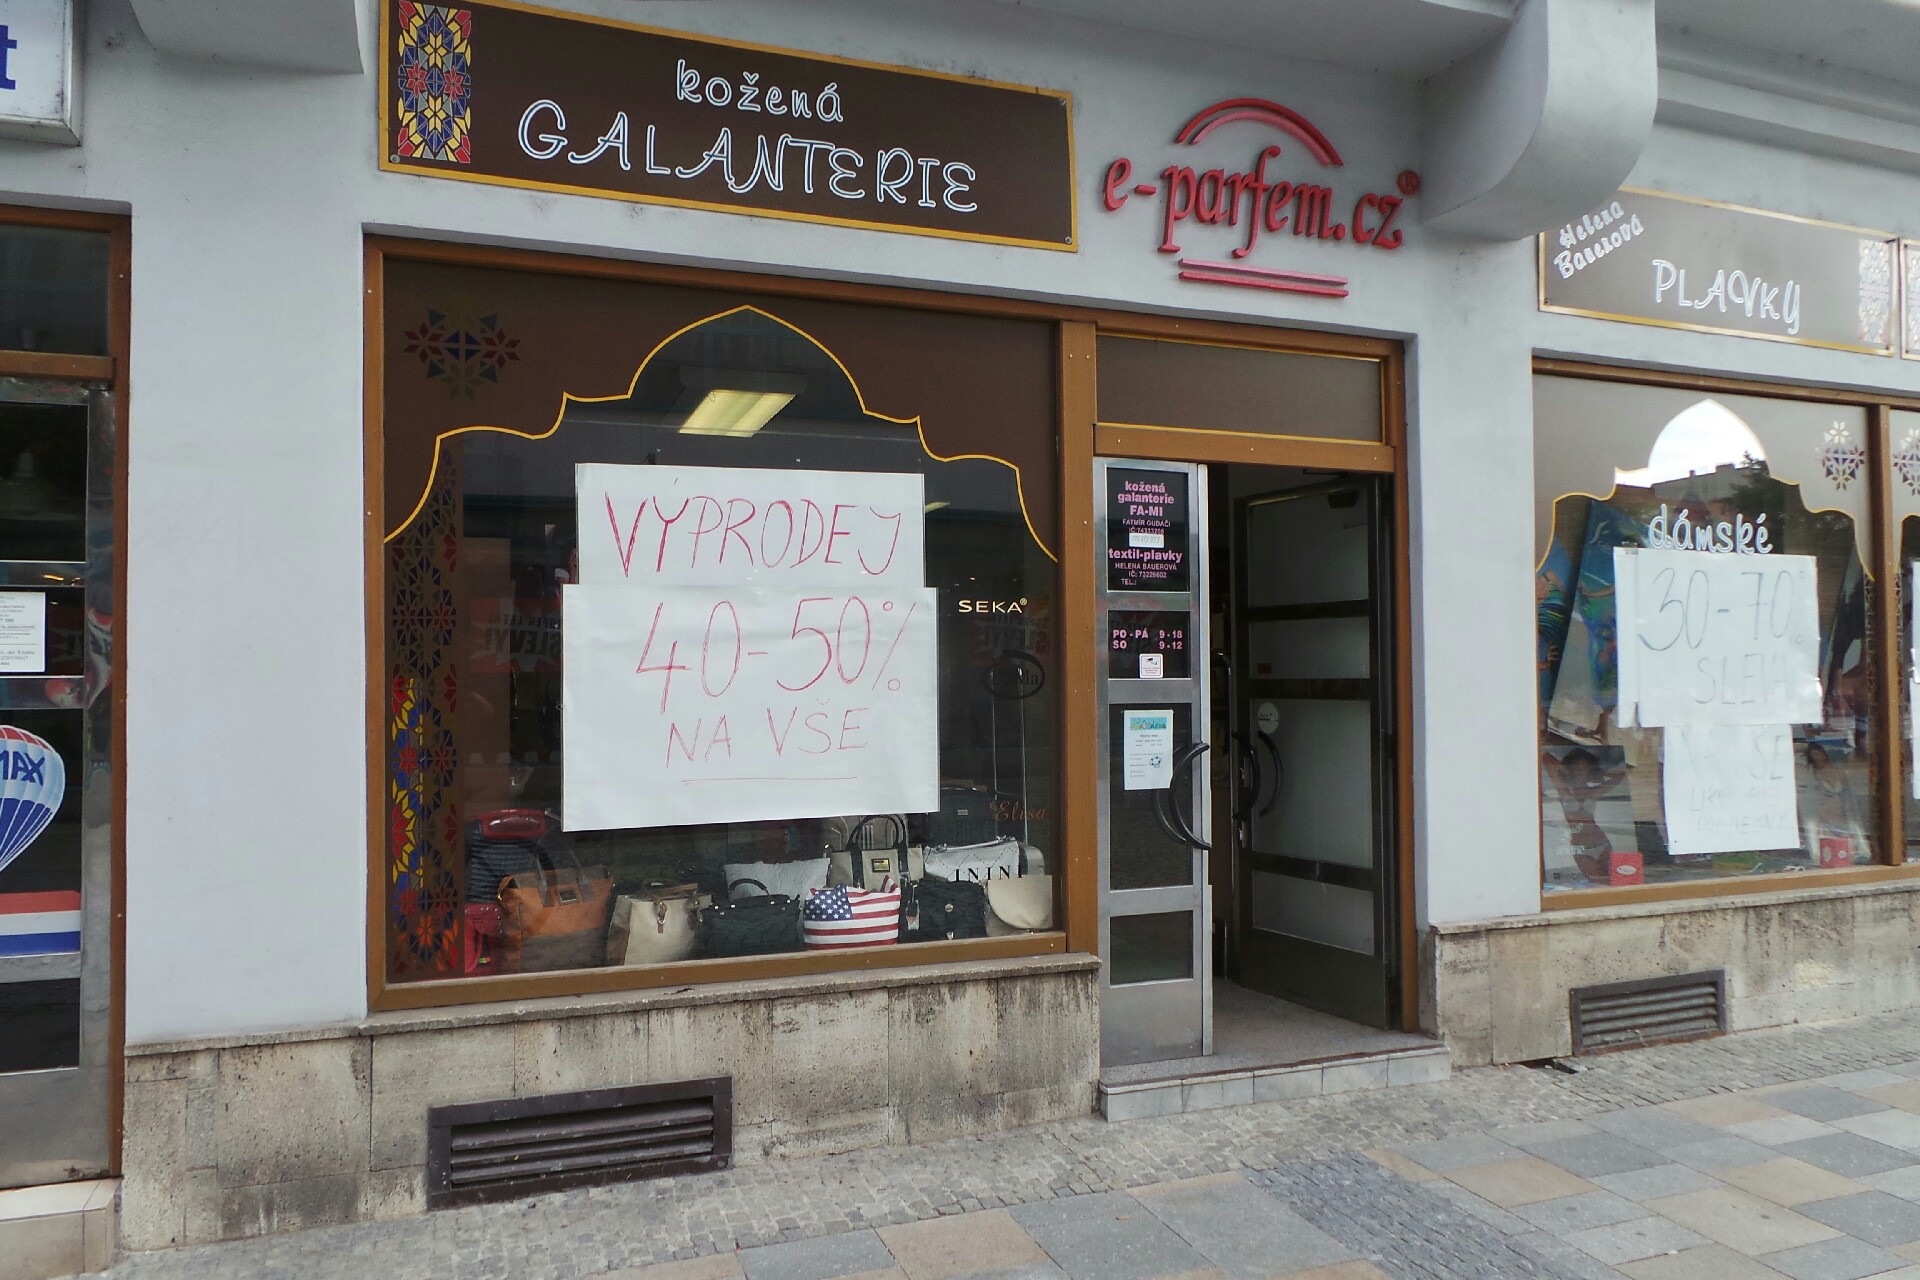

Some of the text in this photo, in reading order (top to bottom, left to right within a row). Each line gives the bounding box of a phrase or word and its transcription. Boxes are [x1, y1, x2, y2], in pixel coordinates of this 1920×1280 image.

[675, 58, 844, 123] kožená
[517, 99, 978, 212] GALANTERIE
[1559, 200, 1625, 249] Helena
[1117, 493, 1175, 504] galanterie
[1125, 480, 1166, 494] kožená
[1129, 505, 1163, 517] FA-MI
[603, 477, 903, 578] VÝPRODEJ
[1648, 503, 1774, 554] dámské
[1108, 548, 1183, 563] textil-plavky
[1115, 562, 1141, 570] HELENA
[1112, 640, 1128, 649] SO
[665, 696, 871, 769] NA VŠE
